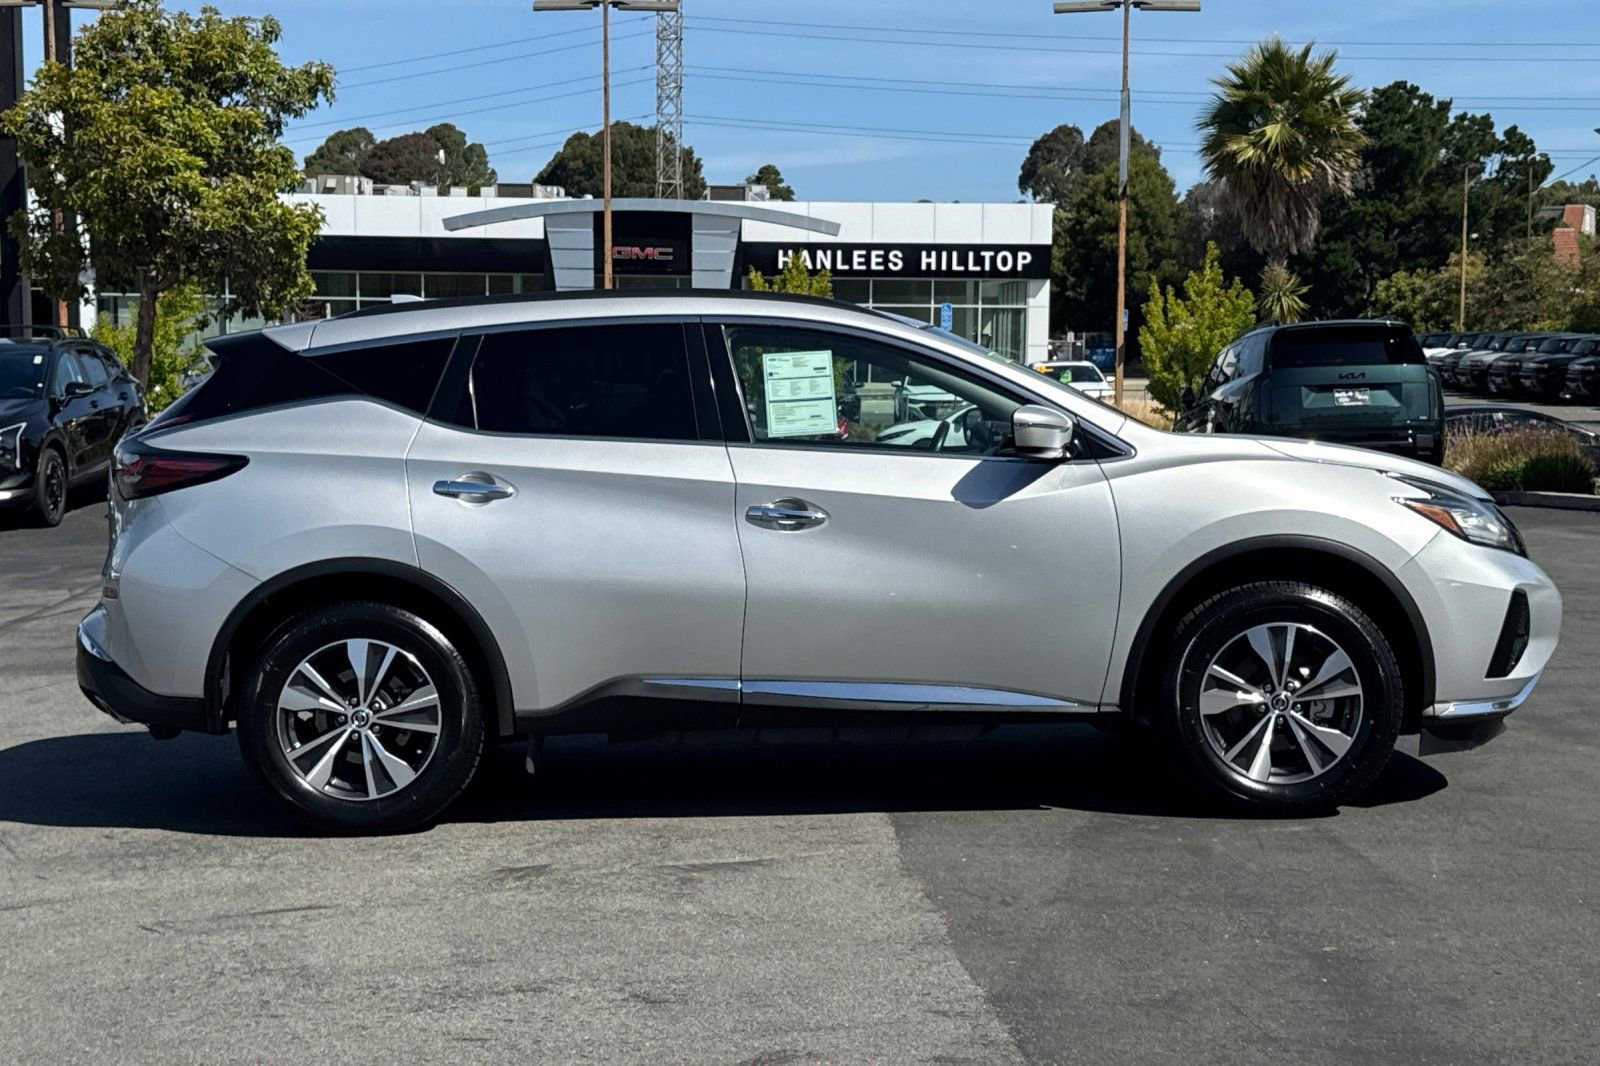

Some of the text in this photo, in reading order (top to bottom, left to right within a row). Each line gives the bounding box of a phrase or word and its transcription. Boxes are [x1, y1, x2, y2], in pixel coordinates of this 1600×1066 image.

[612, 246, 673, 260] GMC
[778, 249, 1032, 271] HANLEES HILLTOP
